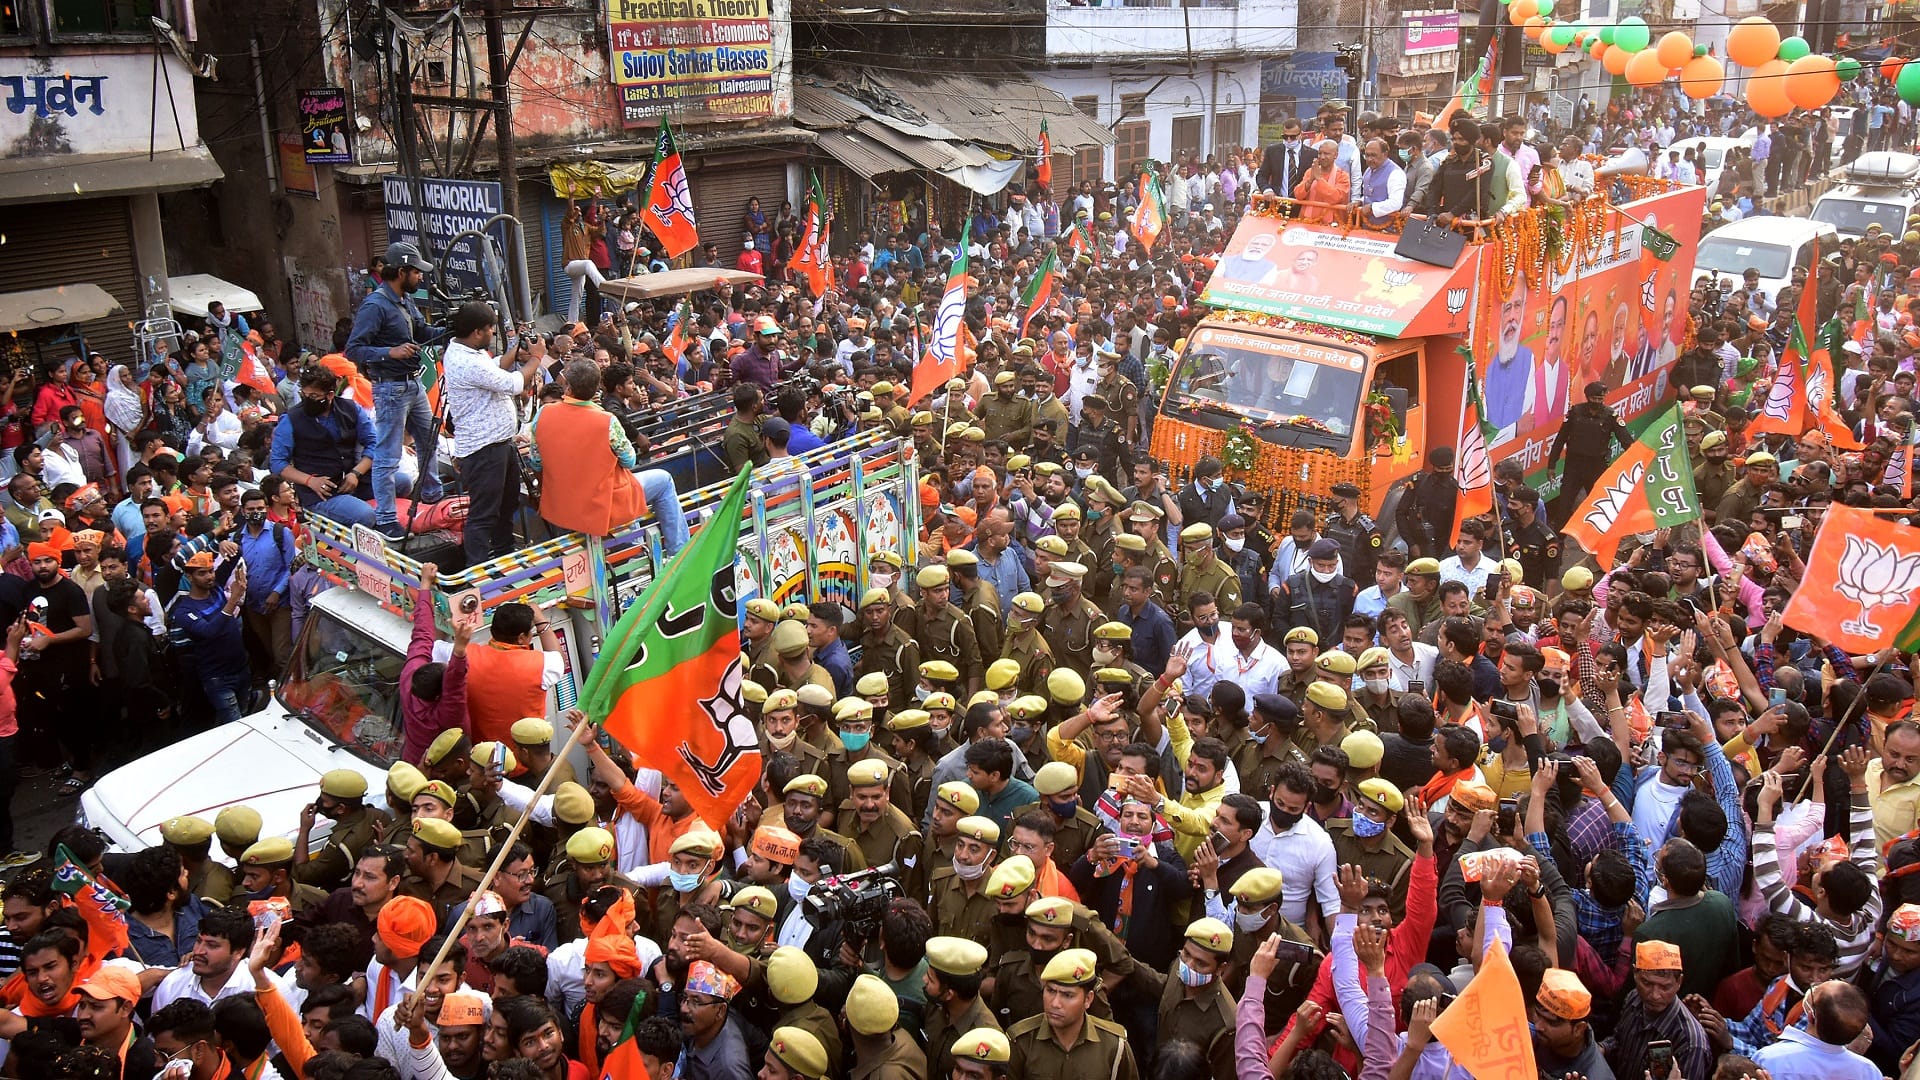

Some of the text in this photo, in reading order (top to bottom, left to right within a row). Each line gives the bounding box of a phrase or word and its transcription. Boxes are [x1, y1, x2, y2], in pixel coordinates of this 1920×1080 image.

[620, 0, 760, 19] Practical & Theory
[659, 24, 704, 45] Account
[712, 21, 769, 43] Economics
[623, 46, 768, 79] Sujoy Sarkar Classes
[624, 87, 649, 102] Lane
[384, 180, 497, 214] KIDWI MEMORIAL
[421, 212, 442, 235] HIGH
[450, 256, 466, 271] Class
[1223, 280, 1266, 297] भारतीय
[1268, 286, 1298, 302] जनता
[1335, 299, 1361, 313] उत्तर
[1363, 302, 1396, 317] प्रदेश
[1214, 333, 1244, 346] भारतीय
[1246, 338, 1271, 351] जनता
[1303, 346, 1323, 359] उत्तर
[1325, 350, 1349, 364] प्रदेश
[566, 554, 586, 583] राधे
